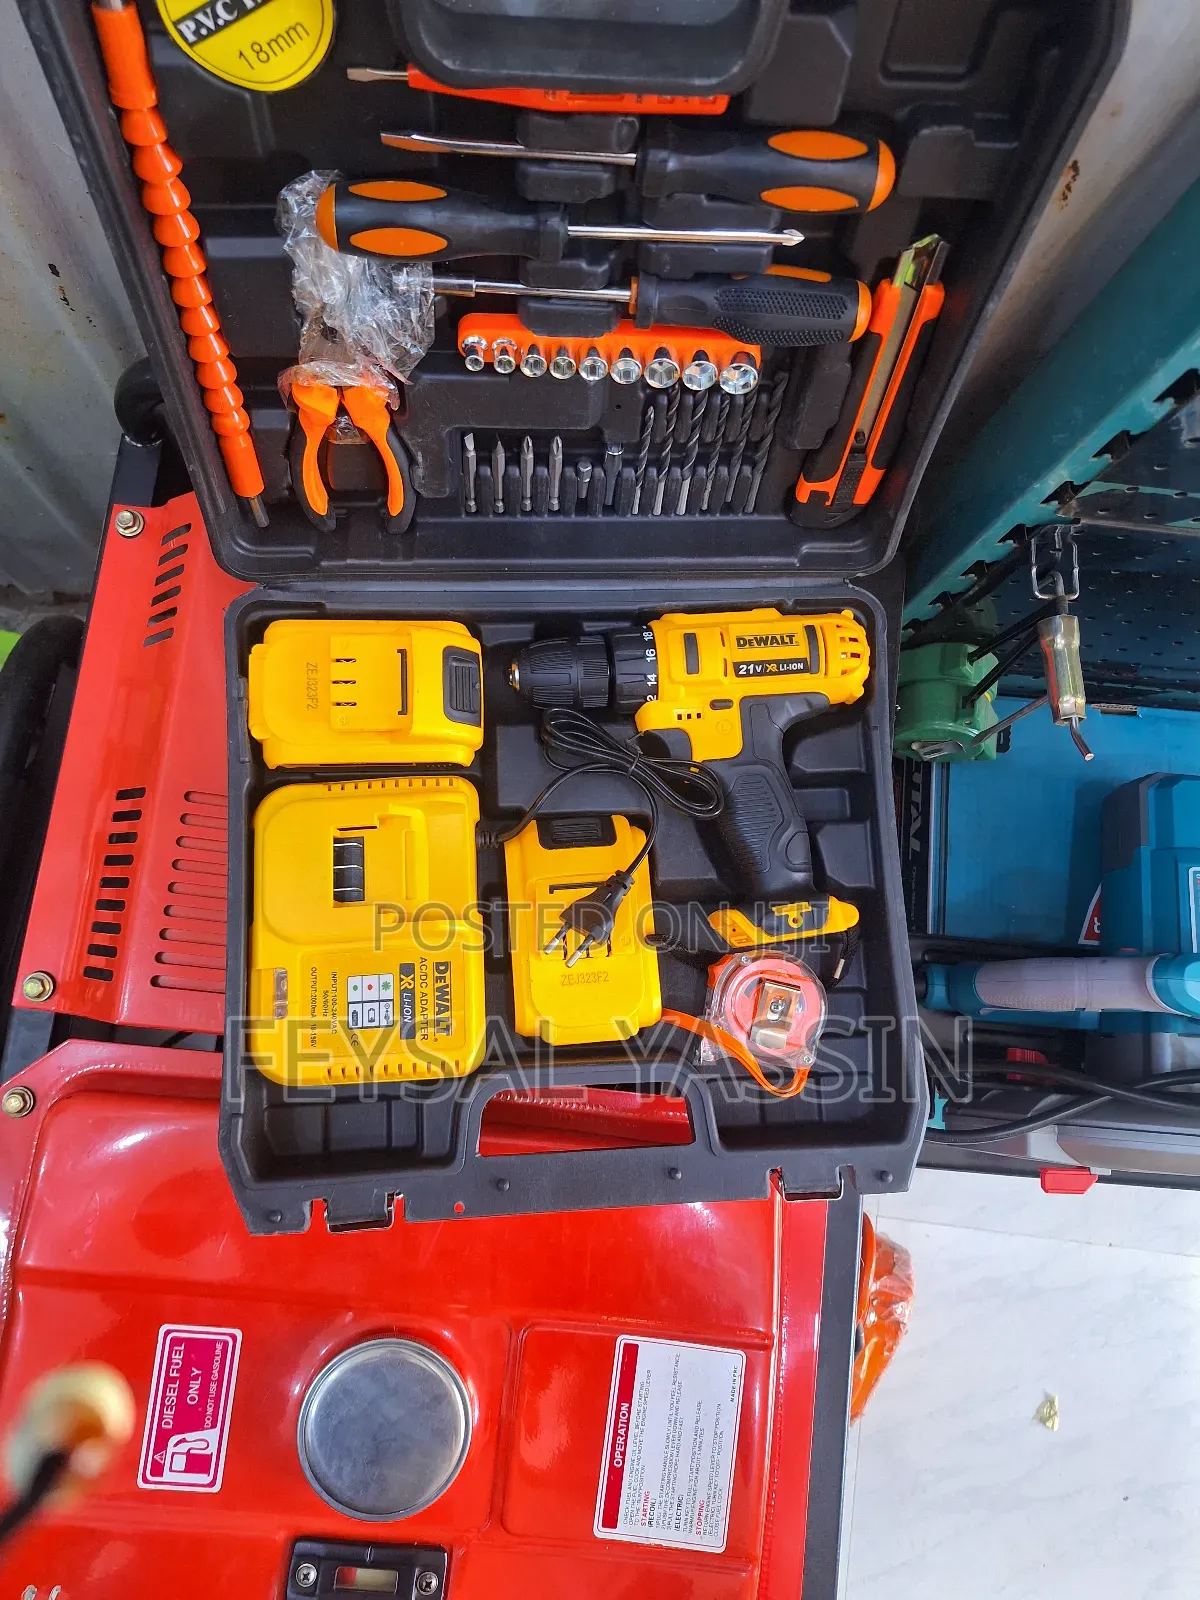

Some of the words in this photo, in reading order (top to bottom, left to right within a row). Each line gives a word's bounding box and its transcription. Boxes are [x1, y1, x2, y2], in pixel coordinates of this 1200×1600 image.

[177, 0, 238, 43] P.V.C
[238, 22, 310, 70] 18mm
[643, 631, 653, 641] 18
[646, 648, 656, 662] 16
[780, 662, 804, 672] LI-ION
[647, 673, 657, 686] 14
[419, 956, 428, 989] AC/DC
[561, 970, 610, 986] ZEJ323F2
[402, 992, 412, 1023] LI-ION
[420, 990, 428, 1041] ADAPTER
[169, 1342, 184, 1376] FUEL
[210, 1341, 223, 1380] GASOLINE
[186, 1367, 202, 1404] ONLY
[208, 1381, 217, 1396] USE
[161, 1379, 179, 1428] DIESEL
[206, 1397, 214, 1414] NOT
[204, 1415, 212, 1427] DO
[613, 1402, 629, 1467] OPERATION
[640, 1490, 650, 1526] STARTING
[674, 1493, 683, 1531] (ELECTRIC)
[695, 1499, 704, 1535] STOPPING
